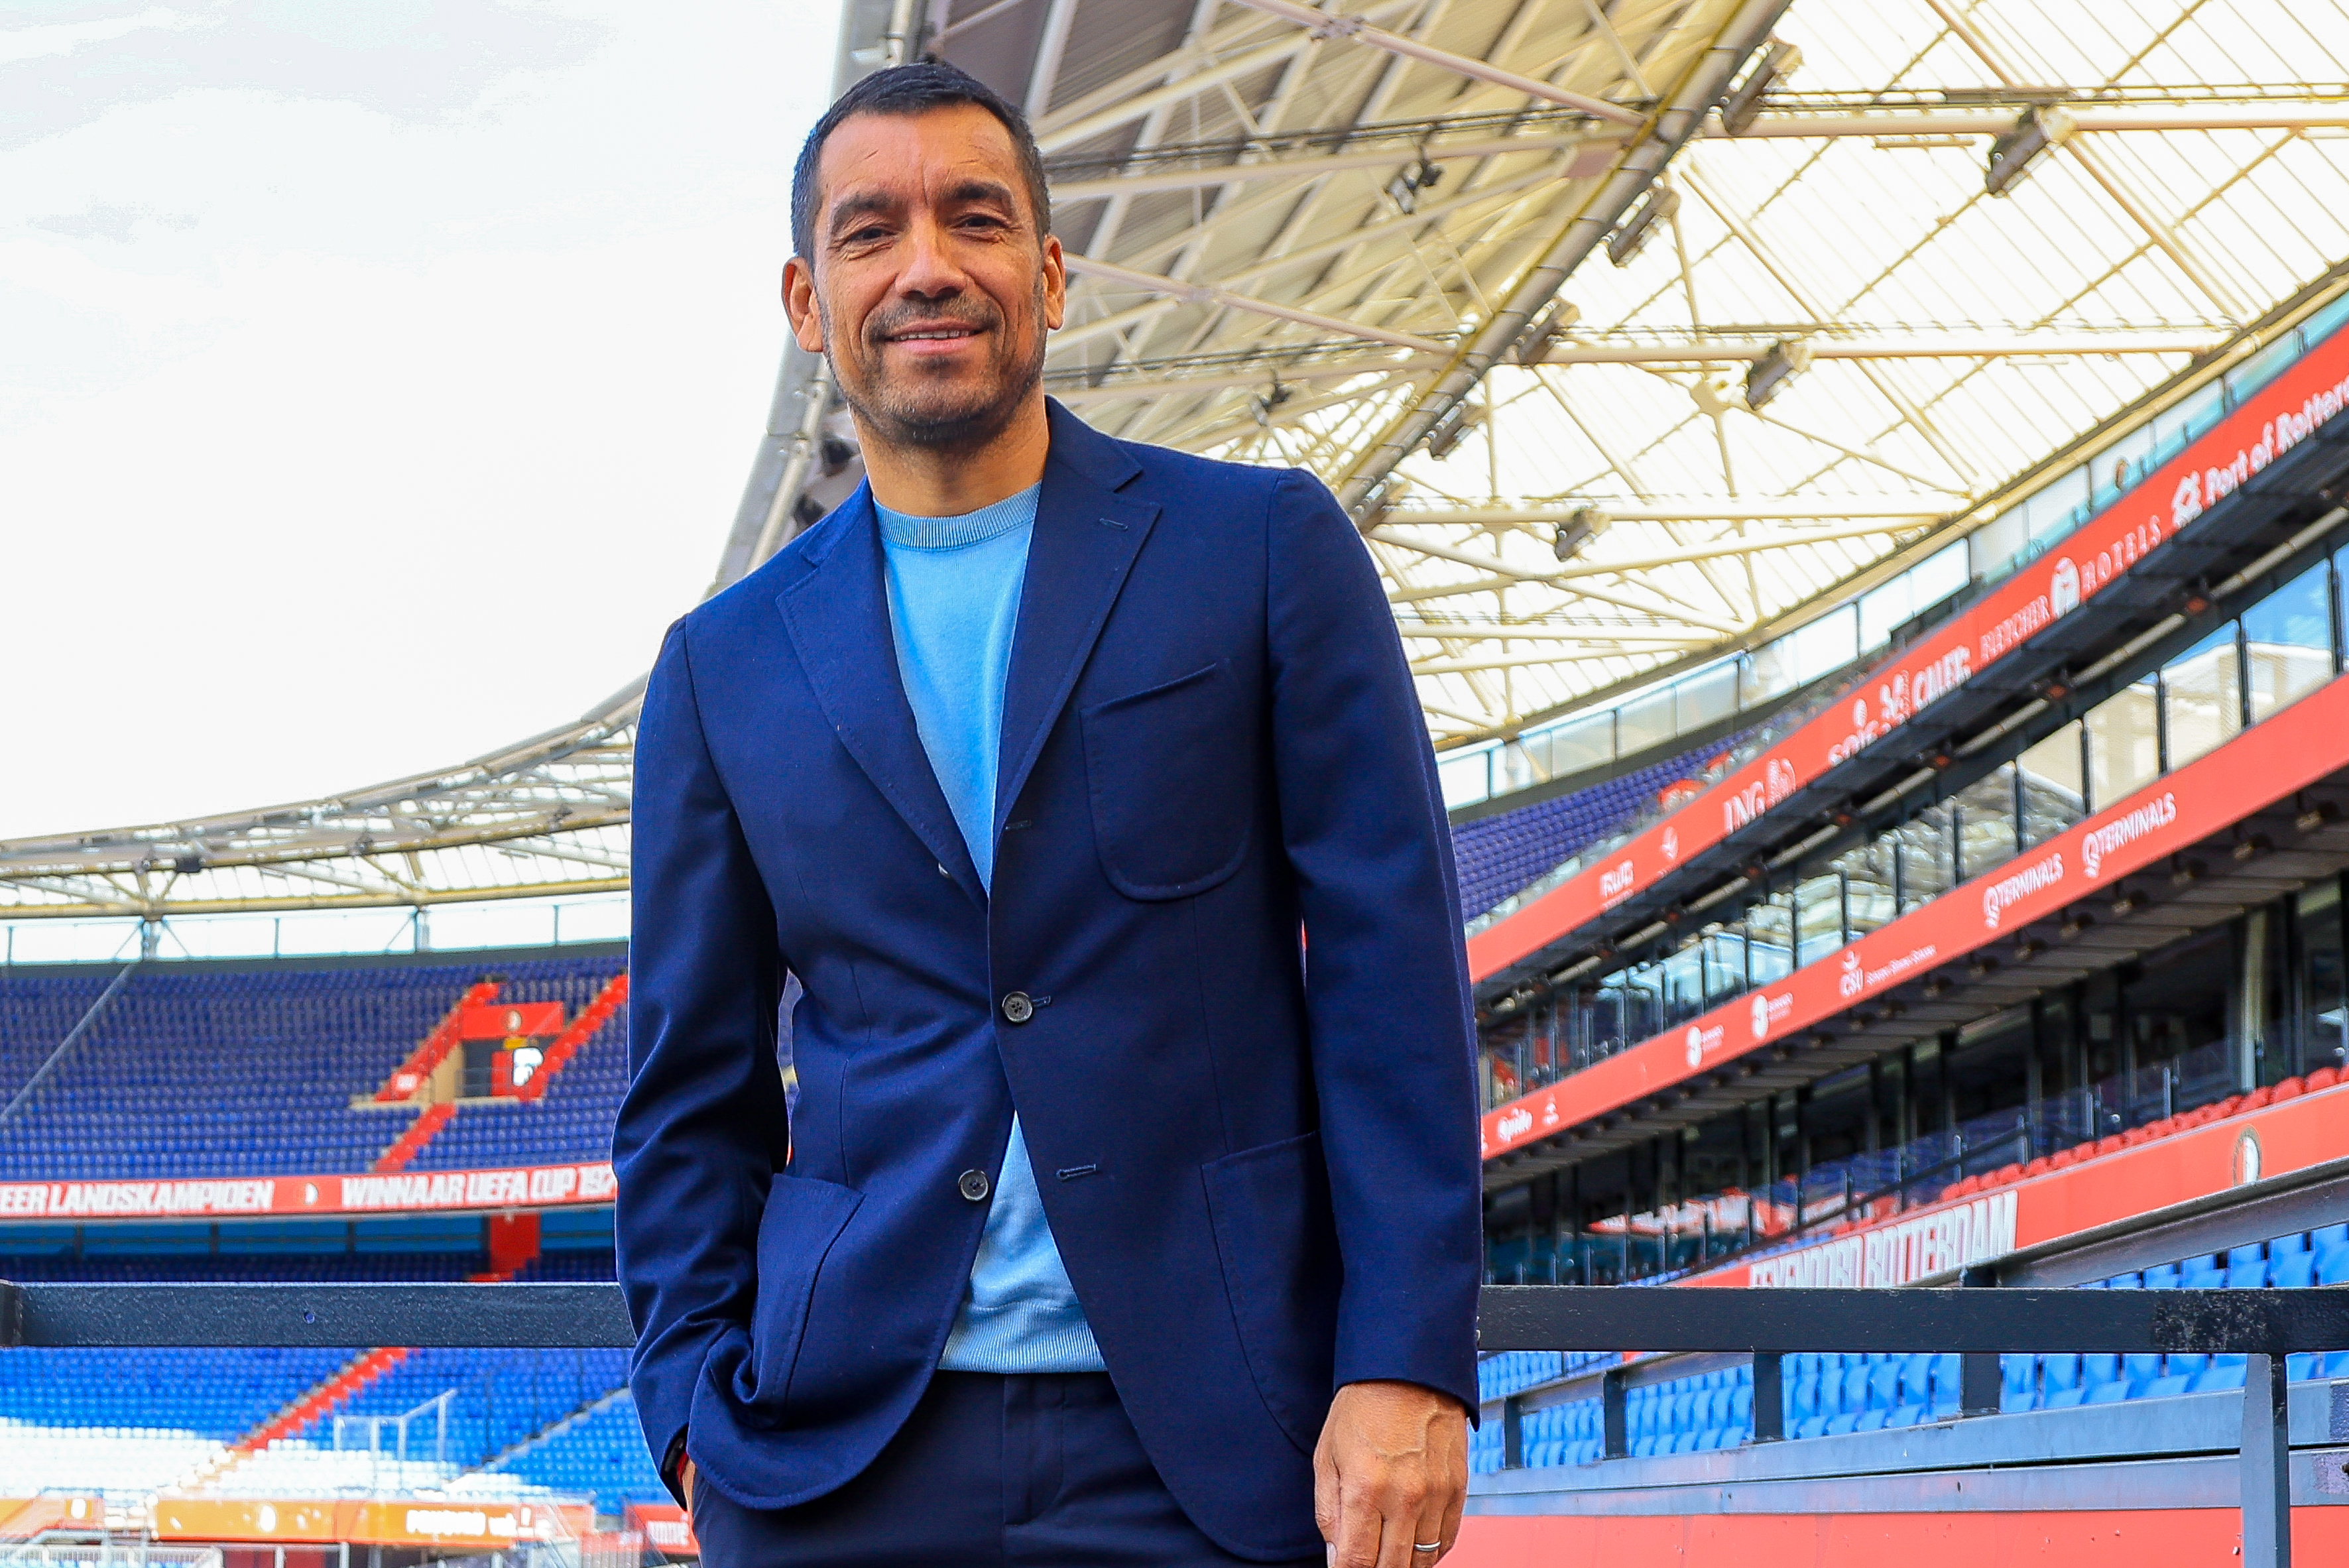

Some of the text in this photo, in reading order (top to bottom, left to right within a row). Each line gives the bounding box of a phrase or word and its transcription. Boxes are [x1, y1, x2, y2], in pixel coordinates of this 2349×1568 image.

[2205, 449, 2248, 506] Port
[2250, 421, 2275, 473] of
[2081, 514, 2161, 593] HOTELS
[1724, 780, 1766, 833] ING
[342, 1175, 465, 1208] WINNAAR
[467, 1170, 528, 1203] UEFA
[530, 1167, 578, 1201] CUP
[1864, 1189, 2018, 1288] ROTTERDAM
